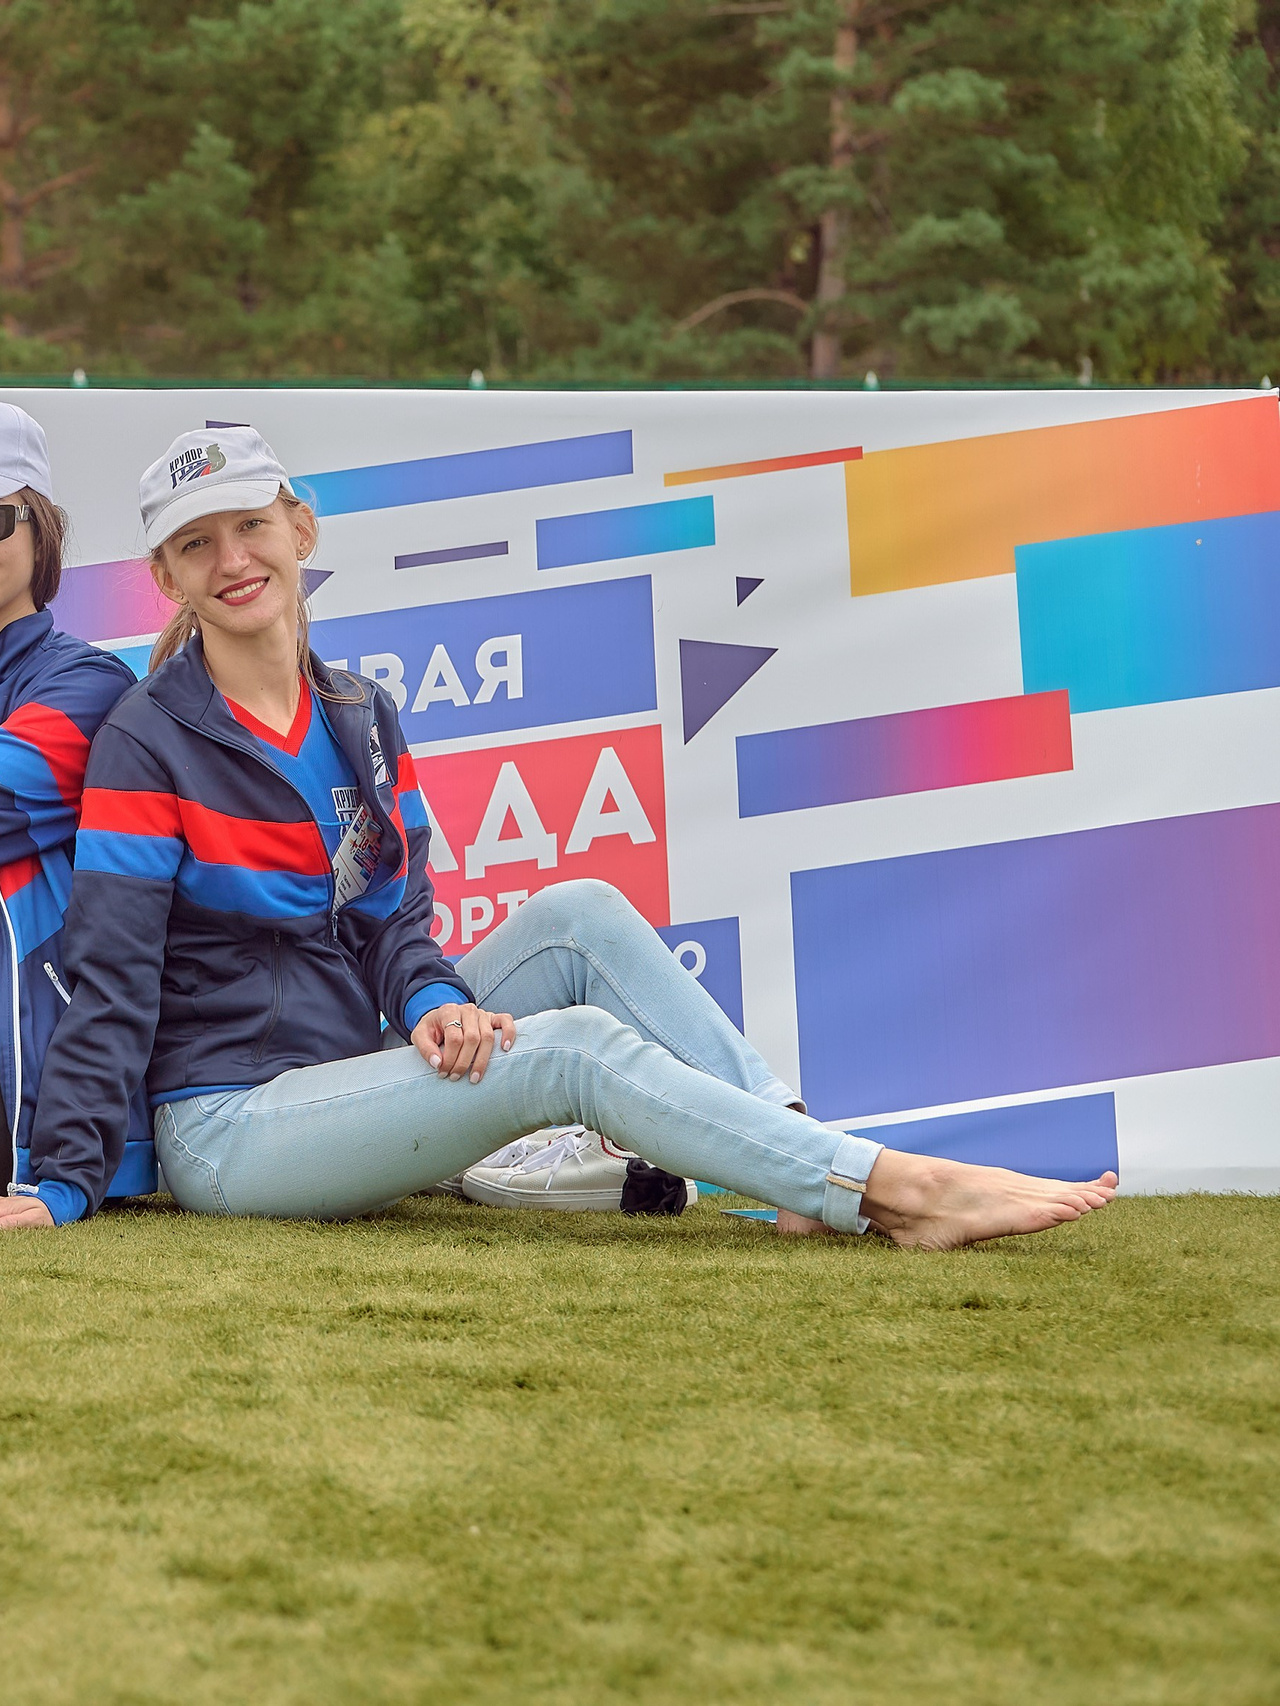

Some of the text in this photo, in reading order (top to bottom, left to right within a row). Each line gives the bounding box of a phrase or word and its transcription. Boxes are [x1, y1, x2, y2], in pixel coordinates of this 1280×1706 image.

[169, 447, 203, 474] КРУДОР
[324, 634, 524, 714] ВАЯ
[429, 889, 528, 945] ОРТ
